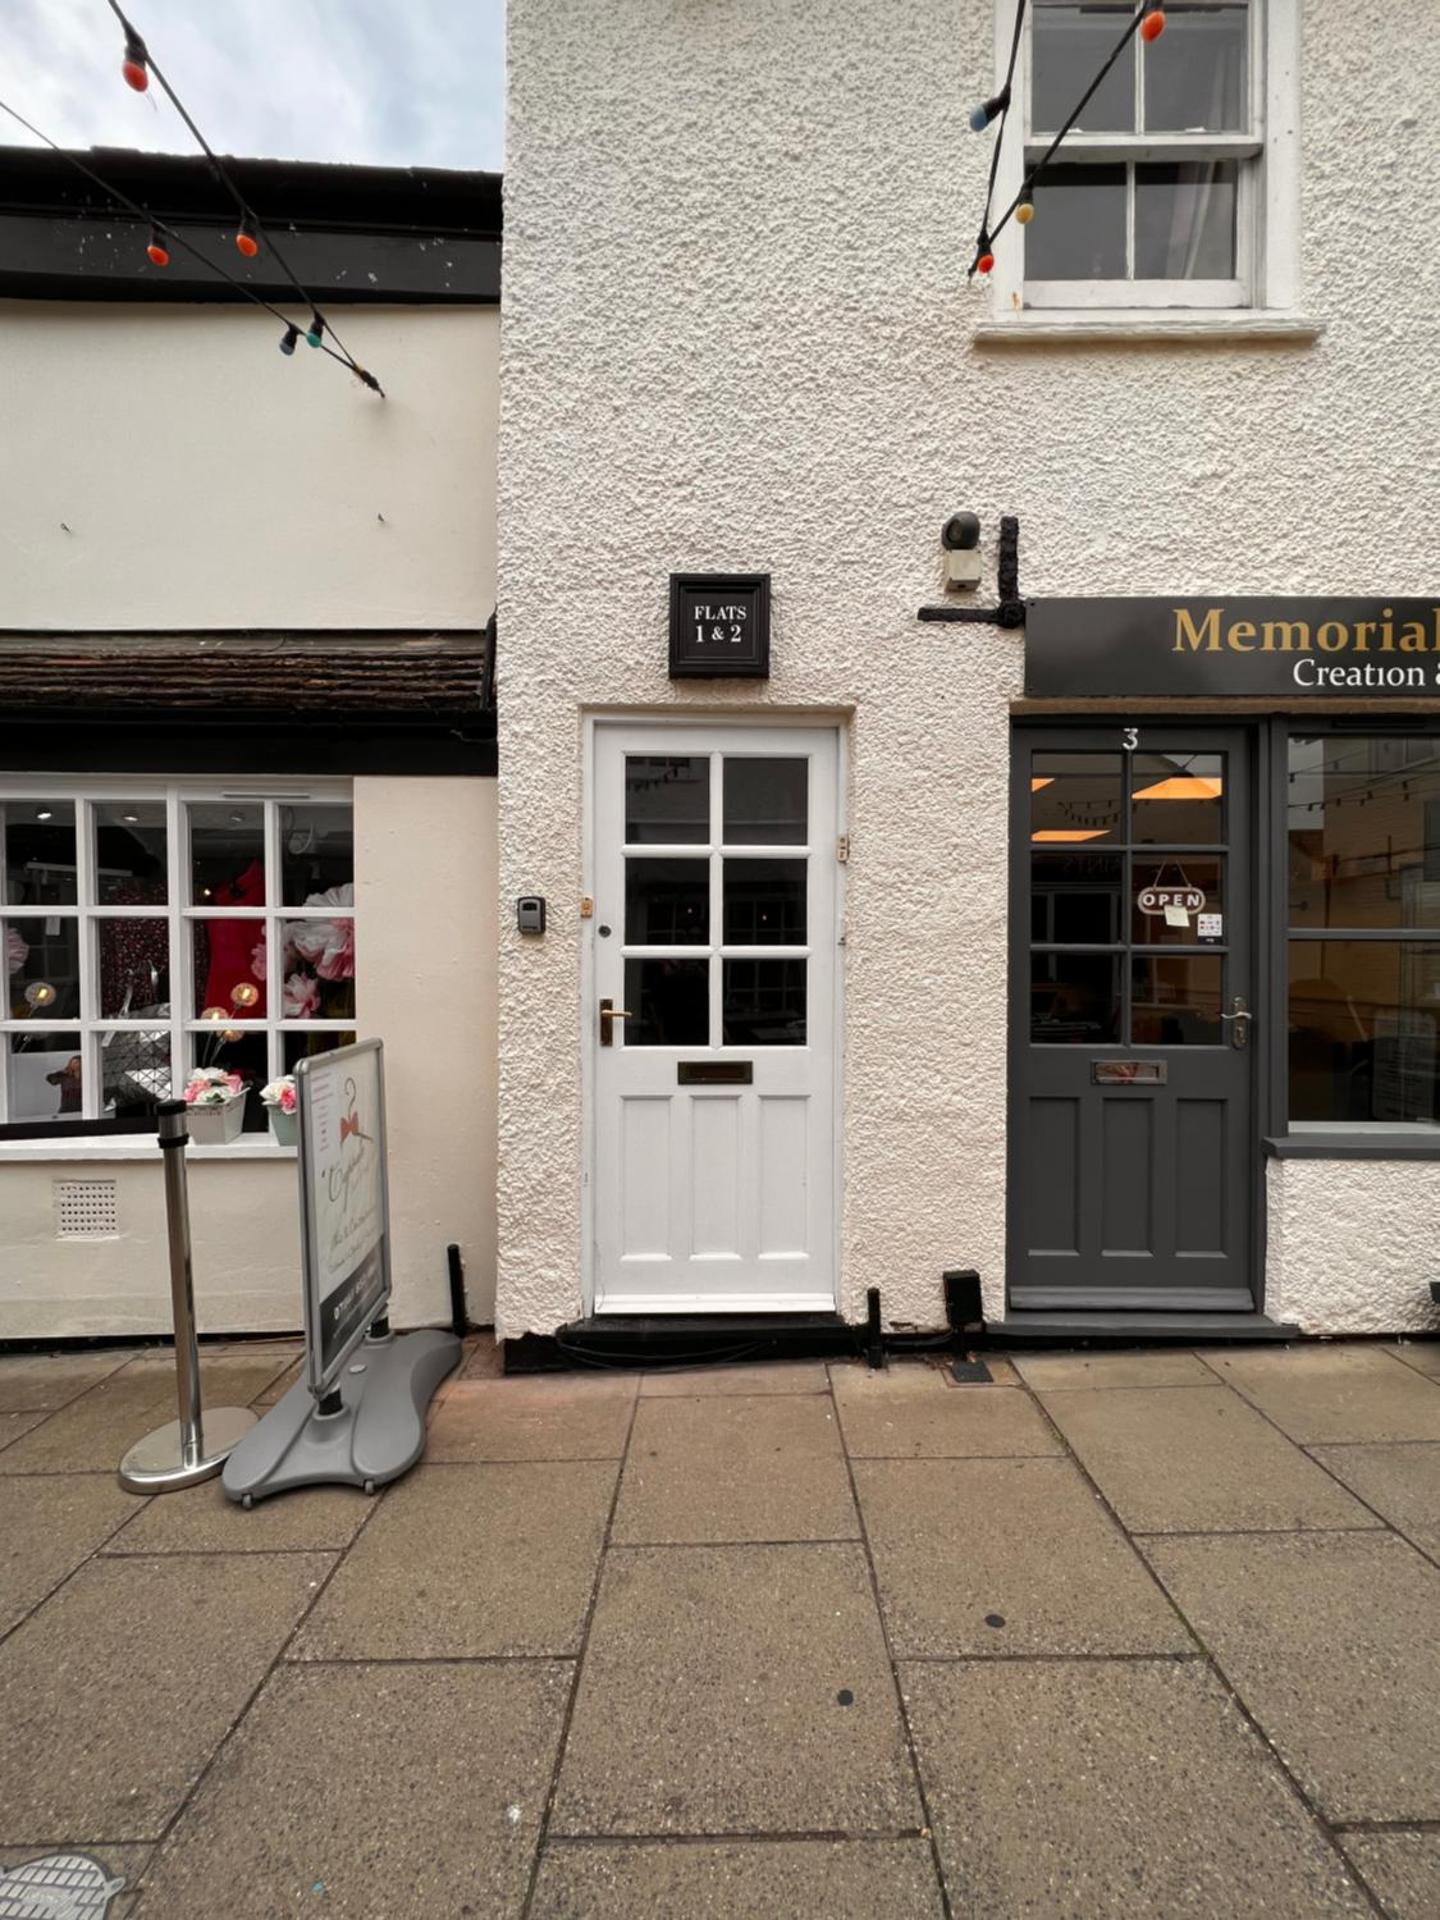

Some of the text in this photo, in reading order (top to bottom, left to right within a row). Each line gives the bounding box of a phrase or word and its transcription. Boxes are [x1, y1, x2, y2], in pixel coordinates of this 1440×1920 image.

[694, 605, 747, 620] FLATS
[696, 624, 742, 643] 1 & 2
[1122, 727, 1139, 750] 3
[1142, 893, 1200, 907] OPEN
